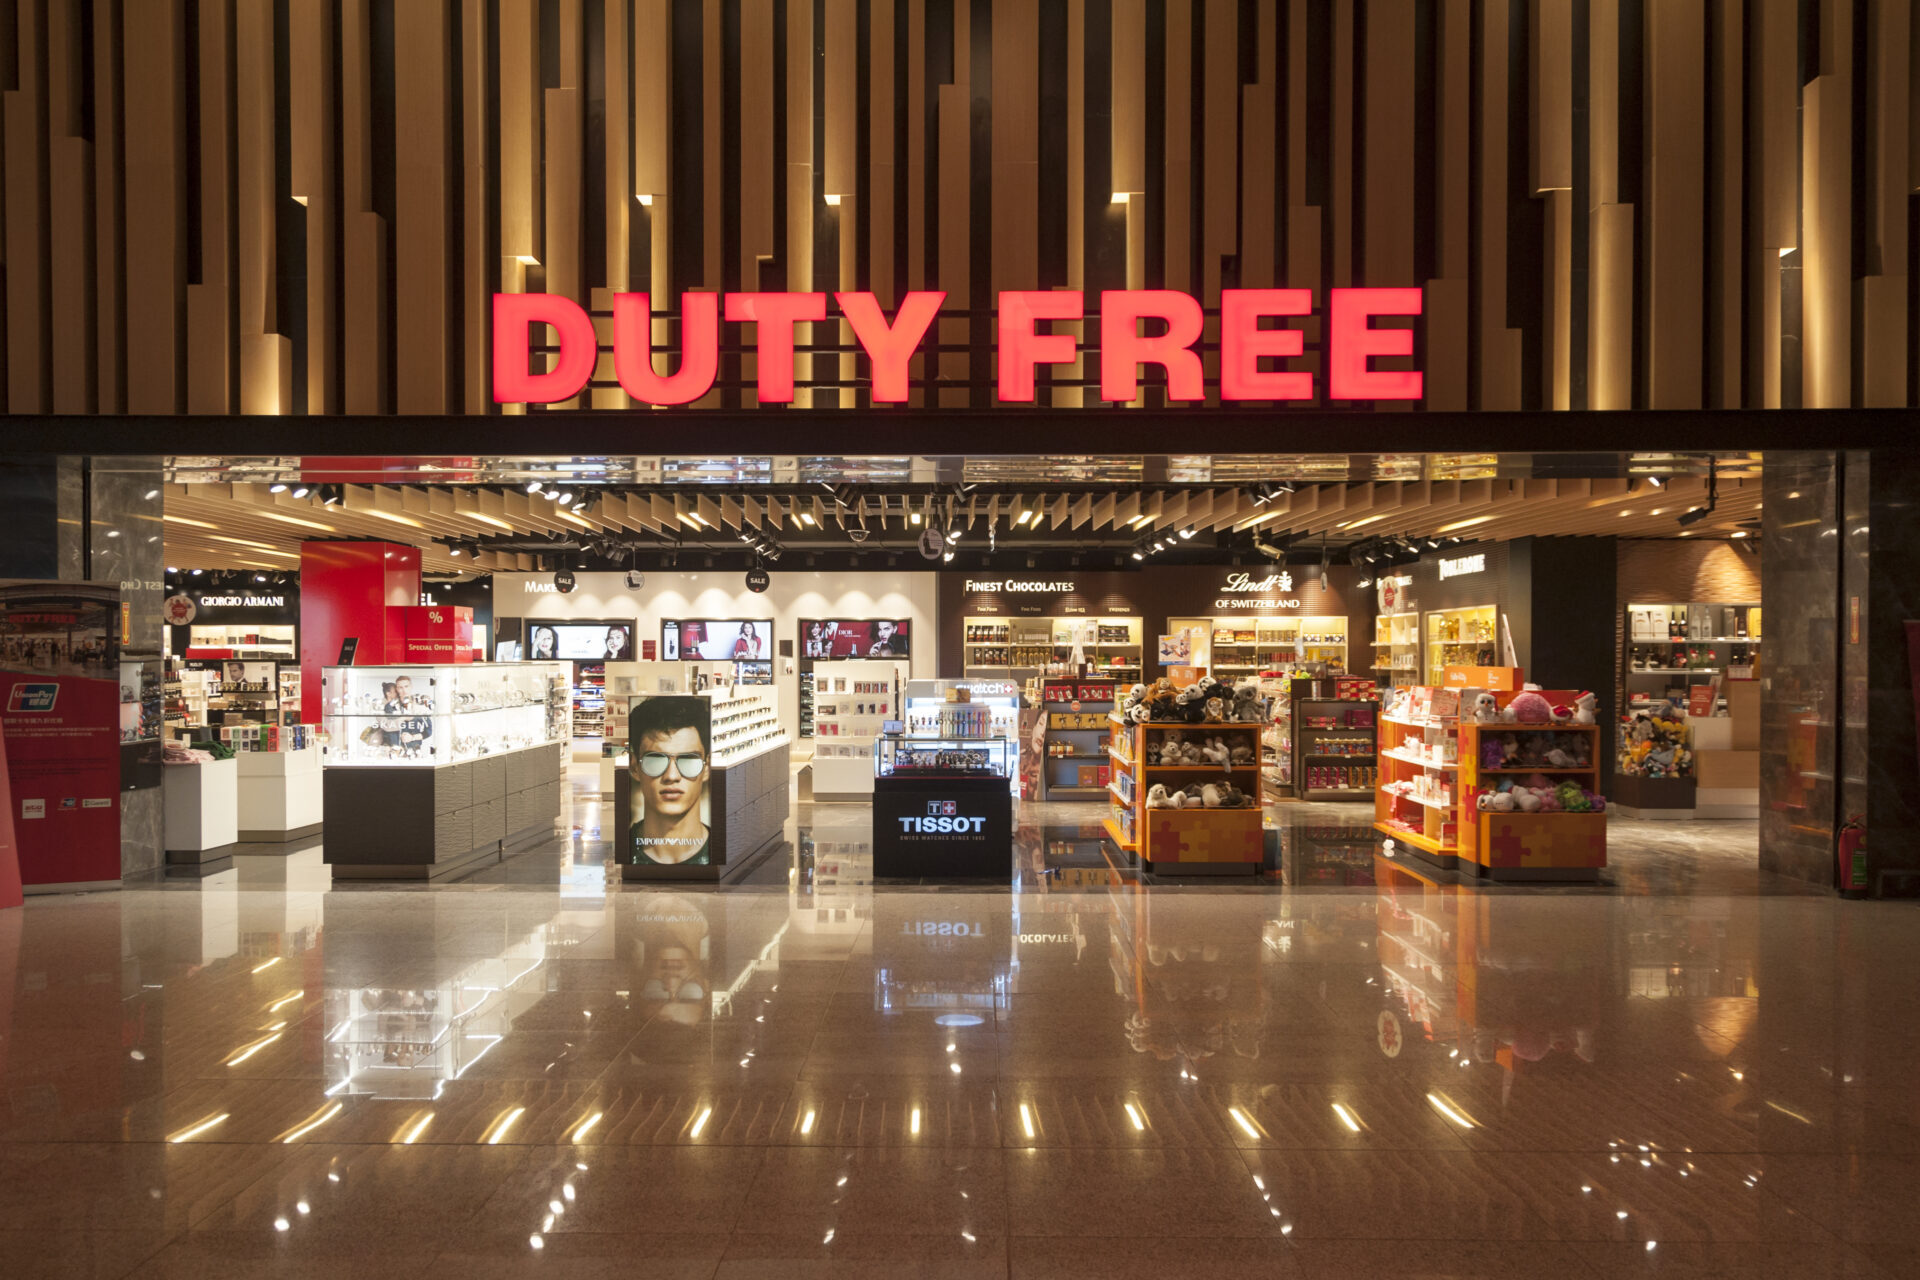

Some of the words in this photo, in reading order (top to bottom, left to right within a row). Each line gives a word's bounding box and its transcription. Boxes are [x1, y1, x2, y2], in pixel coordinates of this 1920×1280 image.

[493, 290, 947, 405] DUTY
[998, 288, 1424, 403] FREE
[1438, 554, 1485, 581] TOBLERONE
[524, 581, 578, 592] MAKEP
[558, 577, 572, 585] SALE
[965, 580, 1003, 592] FINEST
[1005, 580, 1075, 592] CHOCOLATES
[1220, 572, 1279, 592] Lindt
[200, 596, 242, 607] GIORGIO
[243, 596, 284, 606] ARMANI
[1215, 599, 1230, 608] OF
[1231, 599, 1300, 608] SWITZERLAND
[429, 611, 443, 623] %
[408, 643, 432, 651] SPECIAL
[434, 643, 453, 651] OFFER
[14, 690, 53, 699] UnionPay
[371, 722, 425, 730] SKAGEN
[898, 816, 987, 833] TISSOT
[635, 837, 668, 846] EMPORIO
[677, 837, 704, 846] ARMANI
